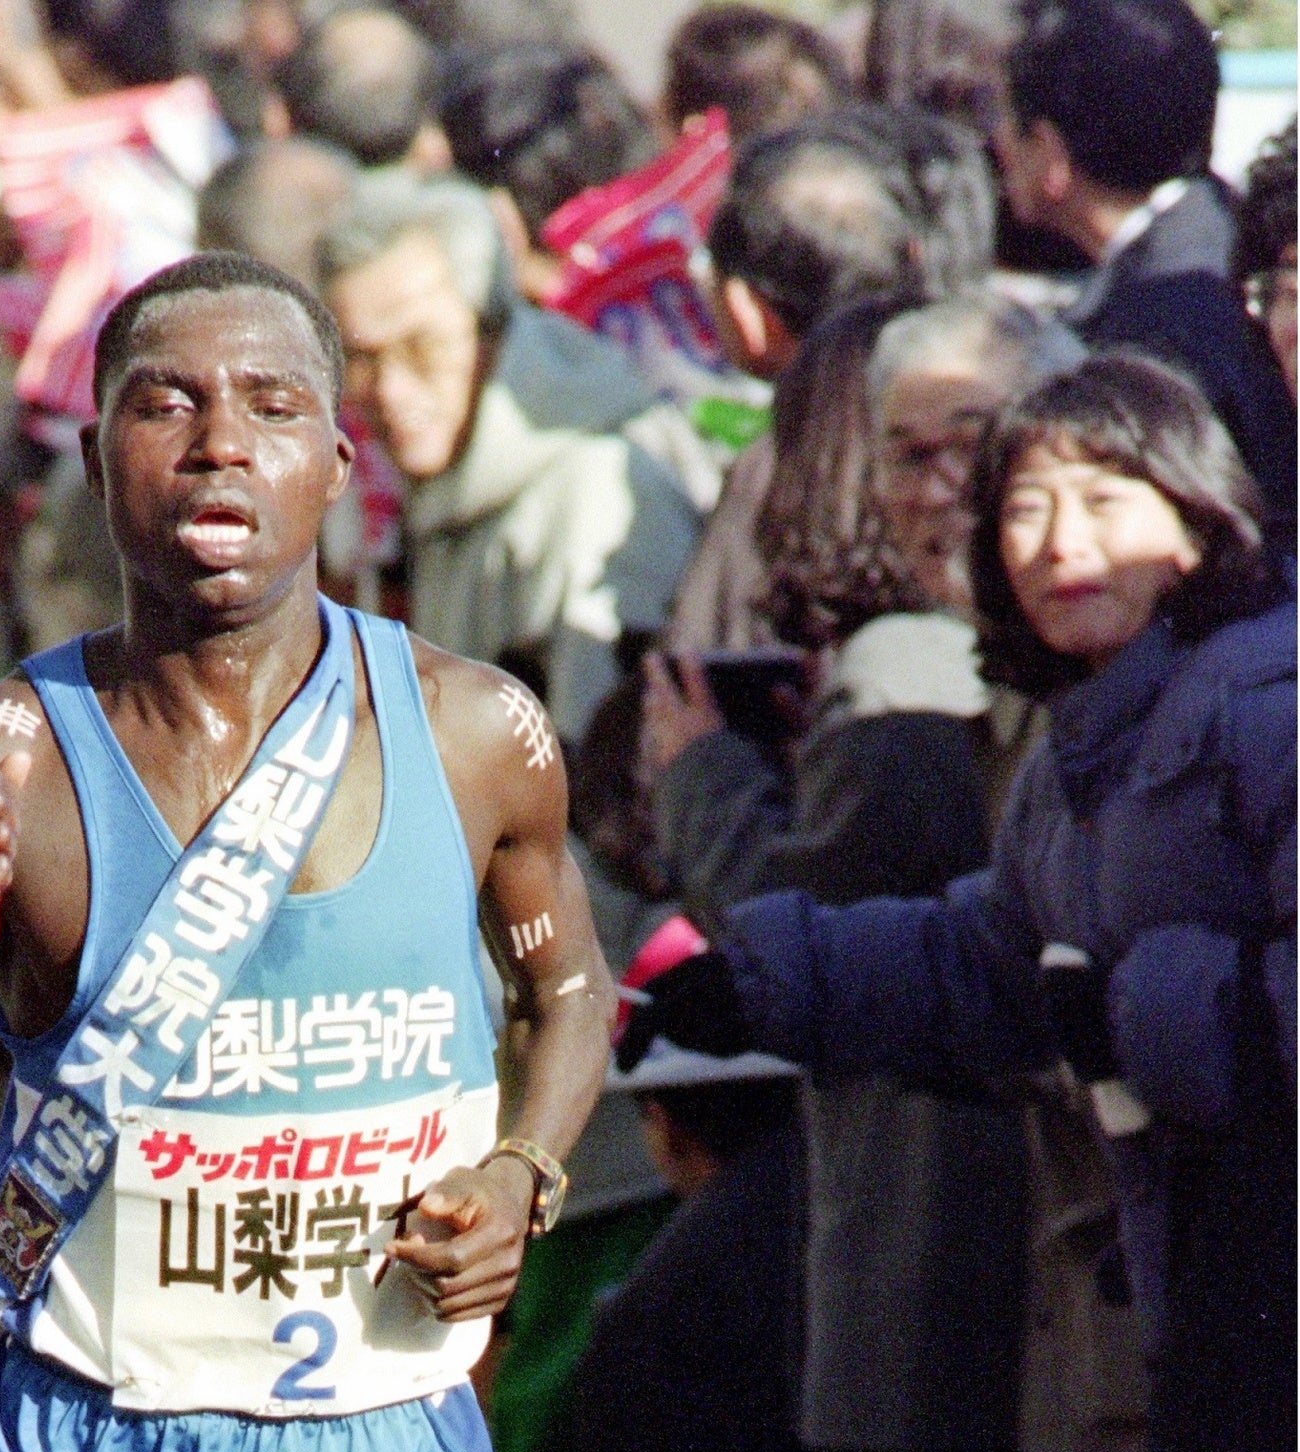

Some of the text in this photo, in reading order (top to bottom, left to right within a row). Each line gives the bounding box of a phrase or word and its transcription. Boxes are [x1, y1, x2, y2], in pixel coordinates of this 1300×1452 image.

[138, 1107, 448, 1182] サッポロビール
[271, 1310, 339, 1402] 2
